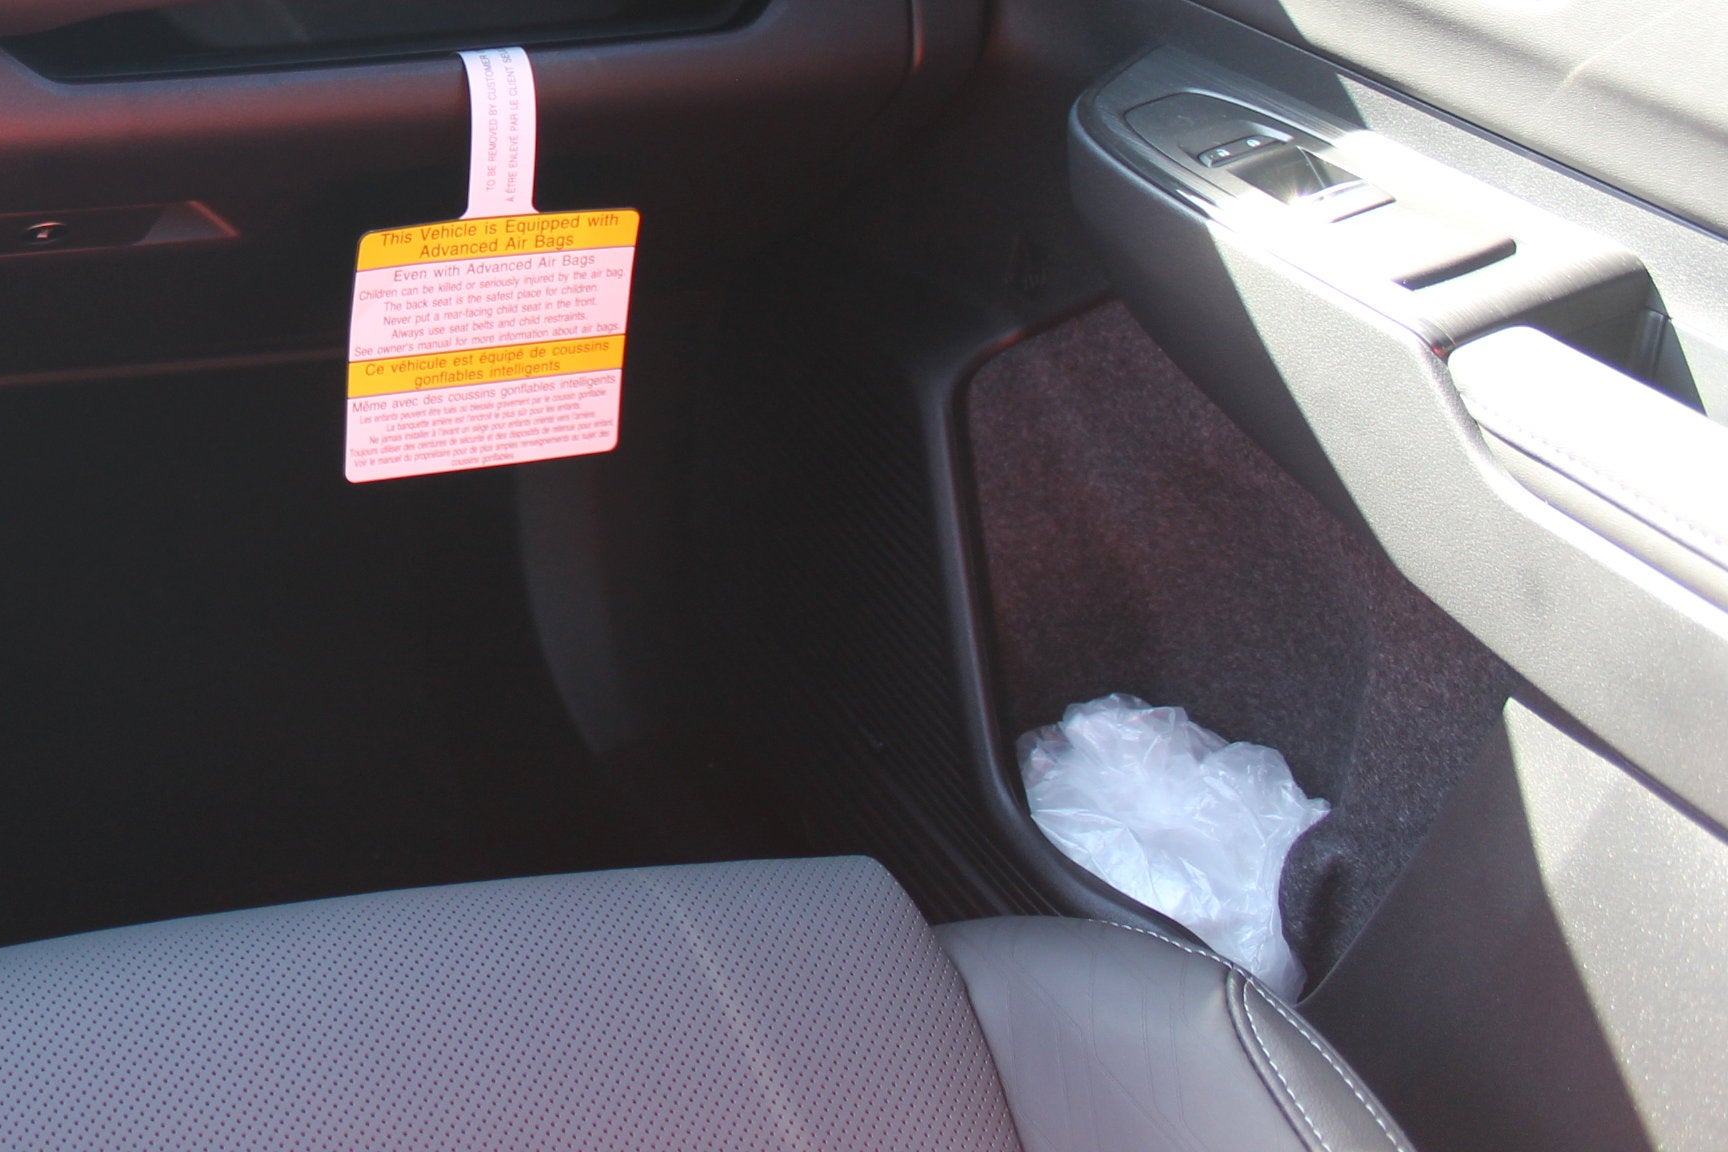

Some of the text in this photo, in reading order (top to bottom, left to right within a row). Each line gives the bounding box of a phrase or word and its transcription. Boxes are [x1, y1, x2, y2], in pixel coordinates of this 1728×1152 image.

[379, 213, 619, 246] This Vehicle is Equipped with
[419, 232, 574, 258] Advanced Air Bags
[393, 252, 596, 282] Even with Advanced Air Bags
[359, 287, 397, 300] Children
[401, 287, 418, 296] can
[422, 284, 433, 294] be
[438, 281, 462, 292] killed
[465, 281, 475, 290] or
[479, 276, 519, 290] seriously
[523, 273, 554, 286] injured
[557, 271, 569, 283] by
[573, 270, 587, 280] the
[383, 299, 402, 312] The
[406, 299, 428, 309] back
[432, 297, 451, 306] seat
[456, 295, 464, 304] is
[467, 293, 481, 303] the
[486, 290, 513, 302] safest
[516, 288, 541, 299] place
[545, 286, 557, 296] for
[382, 313, 411, 326] Never
[415, 312, 430, 324] put
[496, 303, 518, 314] child
[521, 302, 541, 312] seat
[545, 300, 552, 309] in
[556, 298, 571, 308] the
[391, 326, 424, 341] Always
[428, 326, 445, 335] use
[449, 323, 468, 333] seat
[498, 317, 515, 328] and
[354, 345, 373, 356] See
[417, 337, 451, 350] manual
[455, 335, 467, 345] for
[365, 340, 609, 376] Ce véhicule est équipé de coussins
[414, 359, 561, 389] gonflables intelligents
[352, 398, 387, 412] Même
[391, 397, 418, 408] avec
[422, 393, 443, 404] des
[447, 387, 496, 401] coussins
[501, 380, 555, 398] gonflables
[559, 373, 616, 391] intelligents
